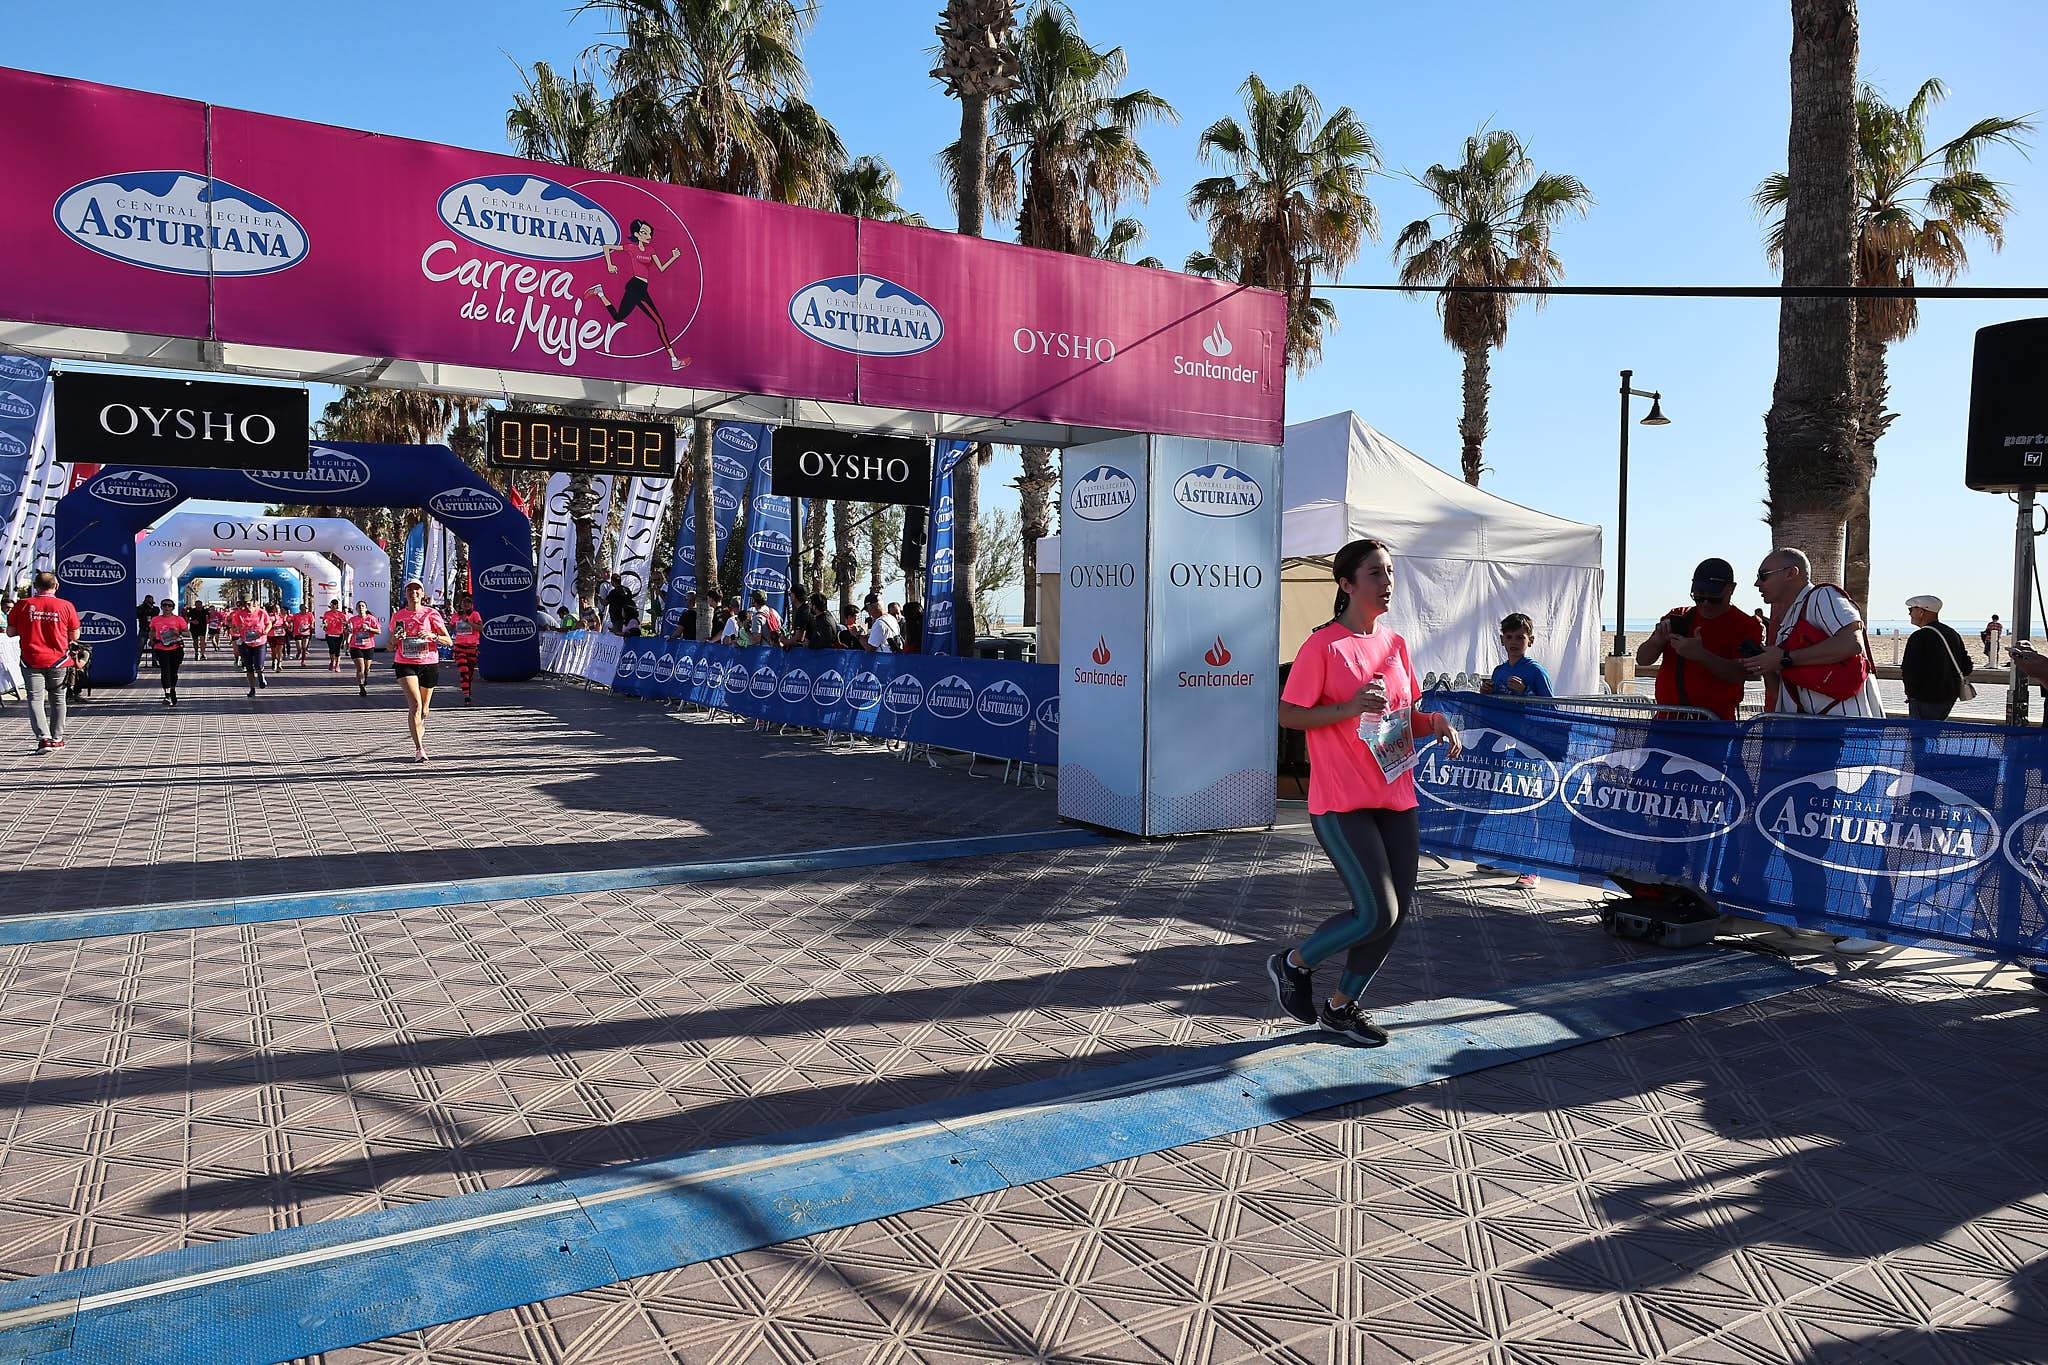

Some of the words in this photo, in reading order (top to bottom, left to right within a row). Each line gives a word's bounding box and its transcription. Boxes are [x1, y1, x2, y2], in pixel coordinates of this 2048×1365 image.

[116, 198, 196, 217] CENTRAL
[482, 195, 540, 213] CENTRAL
[546, 206, 602, 222] LECHERA
[75, 197, 291, 258] ASTURIANA
[453, 194, 607, 247] ASTURIANA
[421, 240, 574, 301] Carrera
[801, 297, 932, 341] ASTURIANA
[827, 297, 875, 311] CENTRAL
[880, 304, 928, 318] LECHERA
[460, 291, 489, 321] de
[495, 293, 516, 325] la
[511, 296, 628, 367] Mujer
[1013, 328, 1117, 363] OYSHO
[0, 364, 39, 379] STURIANA
[1174, 356, 1258, 384] Santander
[100, 403, 276, 445] OYSHO
[501, 421, 661, 468] 00:43:32
[714, 462, 744, 479] STURIANA
[800, 451, 909, 483] OYSHO
[95, 482, 171, 498] ASTURIANA
[1075, 489, 1131, 509] ASTURIANA
[1181, 482, 1256, 506] ASTURIANA
[436, 499, 498, 511] ASTURIANA
[757, 499, 791, 514] ASTURIA
[149, 540, 182, 548] OYSHO
[213, 521, 316, 543] OYSHO
[61, 565, 121, 579] ASTURIANA
[1070, 563, 1135, 588] OYSHO
[1170, 563, 1262, 589] OYSHO
[80, 626, 121, 635] URIANA
[1075, 667, 1127, 687] Santander
[1178, 671, 1254, 688] Santander
[885, 688, 920, 705] ASTURIANA
[929, 690, 969, 709] ASTURIANA
[980, 695, 1023, 716] ASTURIANA
[1453, 753, 1490, 765] NTRAL
[1495, 758, 1545, 773] LECHERA
[1419, 752, 1544, 800] ASTURIANA
[1598, 773, 1658, 789] CENTRAL
[1663, 781, 1726, 797] LECHERA
[1571, 772, 1727, 825] ASTURIANA
[1809, 796, 1882, 814] CENTRAL
[1891, 803, 1973, 824] LECHERA
[1768, 796, 1976, 858] ASTURIANA
